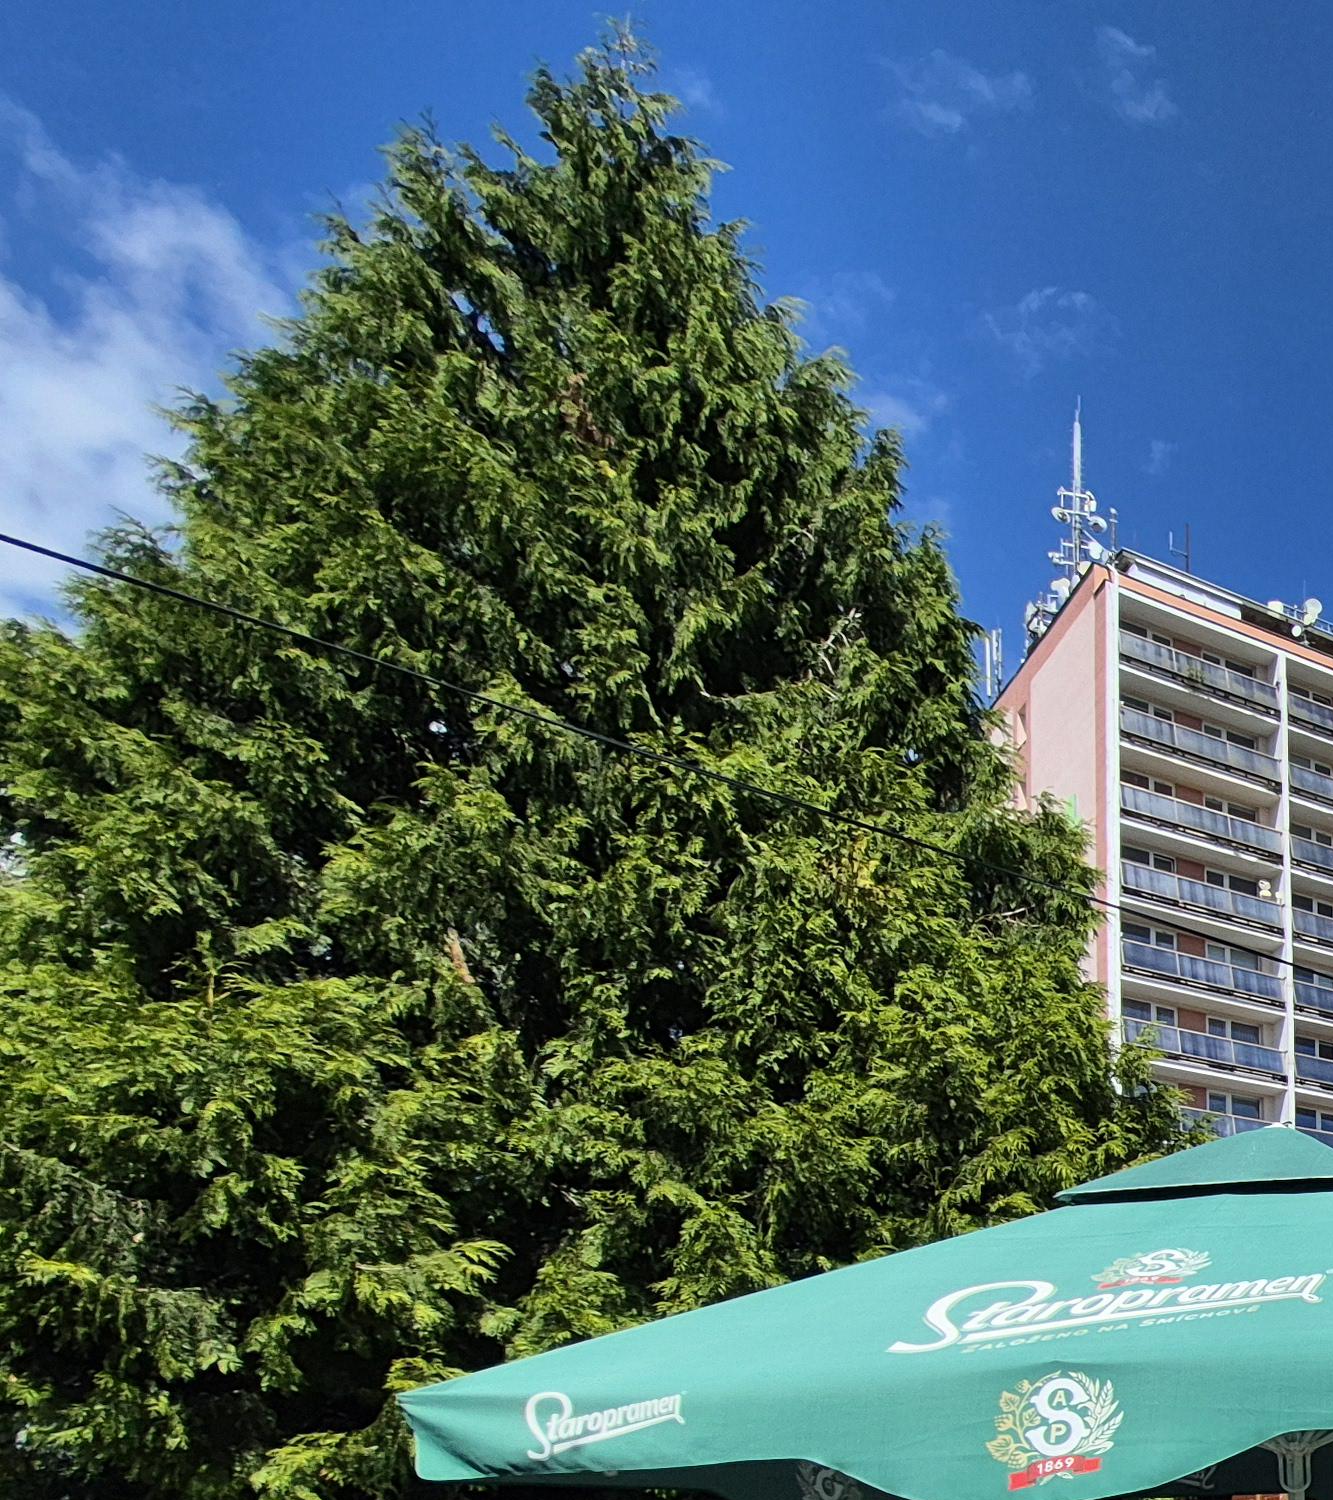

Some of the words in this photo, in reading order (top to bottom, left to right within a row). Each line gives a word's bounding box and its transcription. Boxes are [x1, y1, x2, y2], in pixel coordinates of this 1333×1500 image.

[886, 1270, 1326, 1354] Staropramen
[525, 1391, 687, 1461] Staropramen
[1036, 1456, 1075, 1475] 1869
